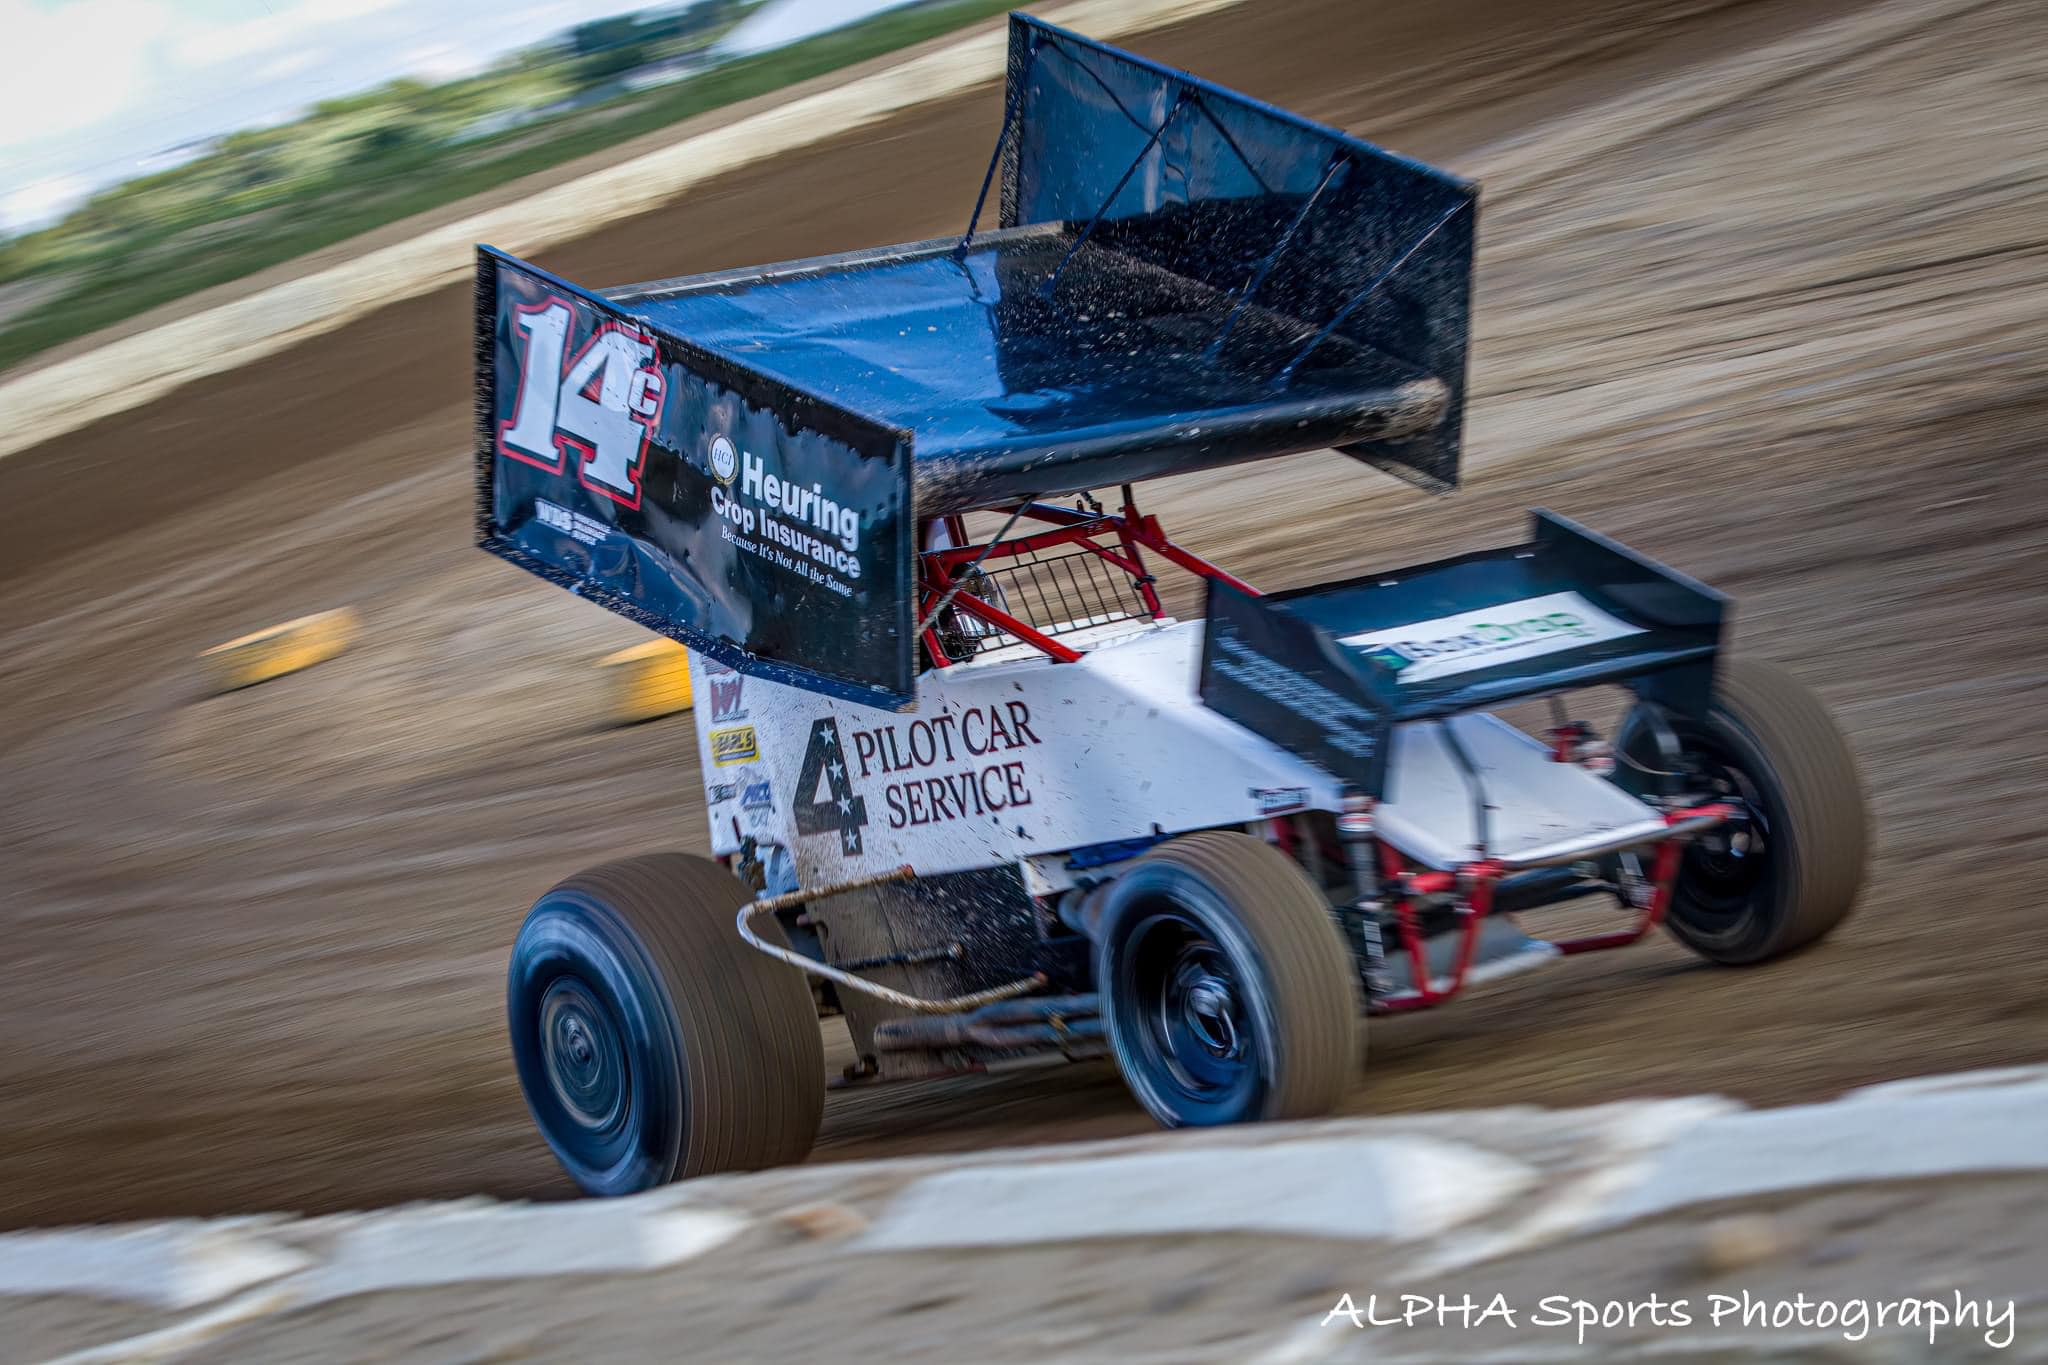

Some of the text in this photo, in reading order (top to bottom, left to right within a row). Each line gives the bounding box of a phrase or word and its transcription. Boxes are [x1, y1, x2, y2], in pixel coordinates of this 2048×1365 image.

[713, 447, 732, 466] HCI
[711, 486, 861, 579] Crop Insurance
[743, 451, 860, 552] Heuring
[721, 525, 854, 598] Because It's Not All the Same
[852, 700, 1042, 777] PILOT CAR
[793, 717, 868, 857] 4
[885, 761, 1033, 829] SERVICE
